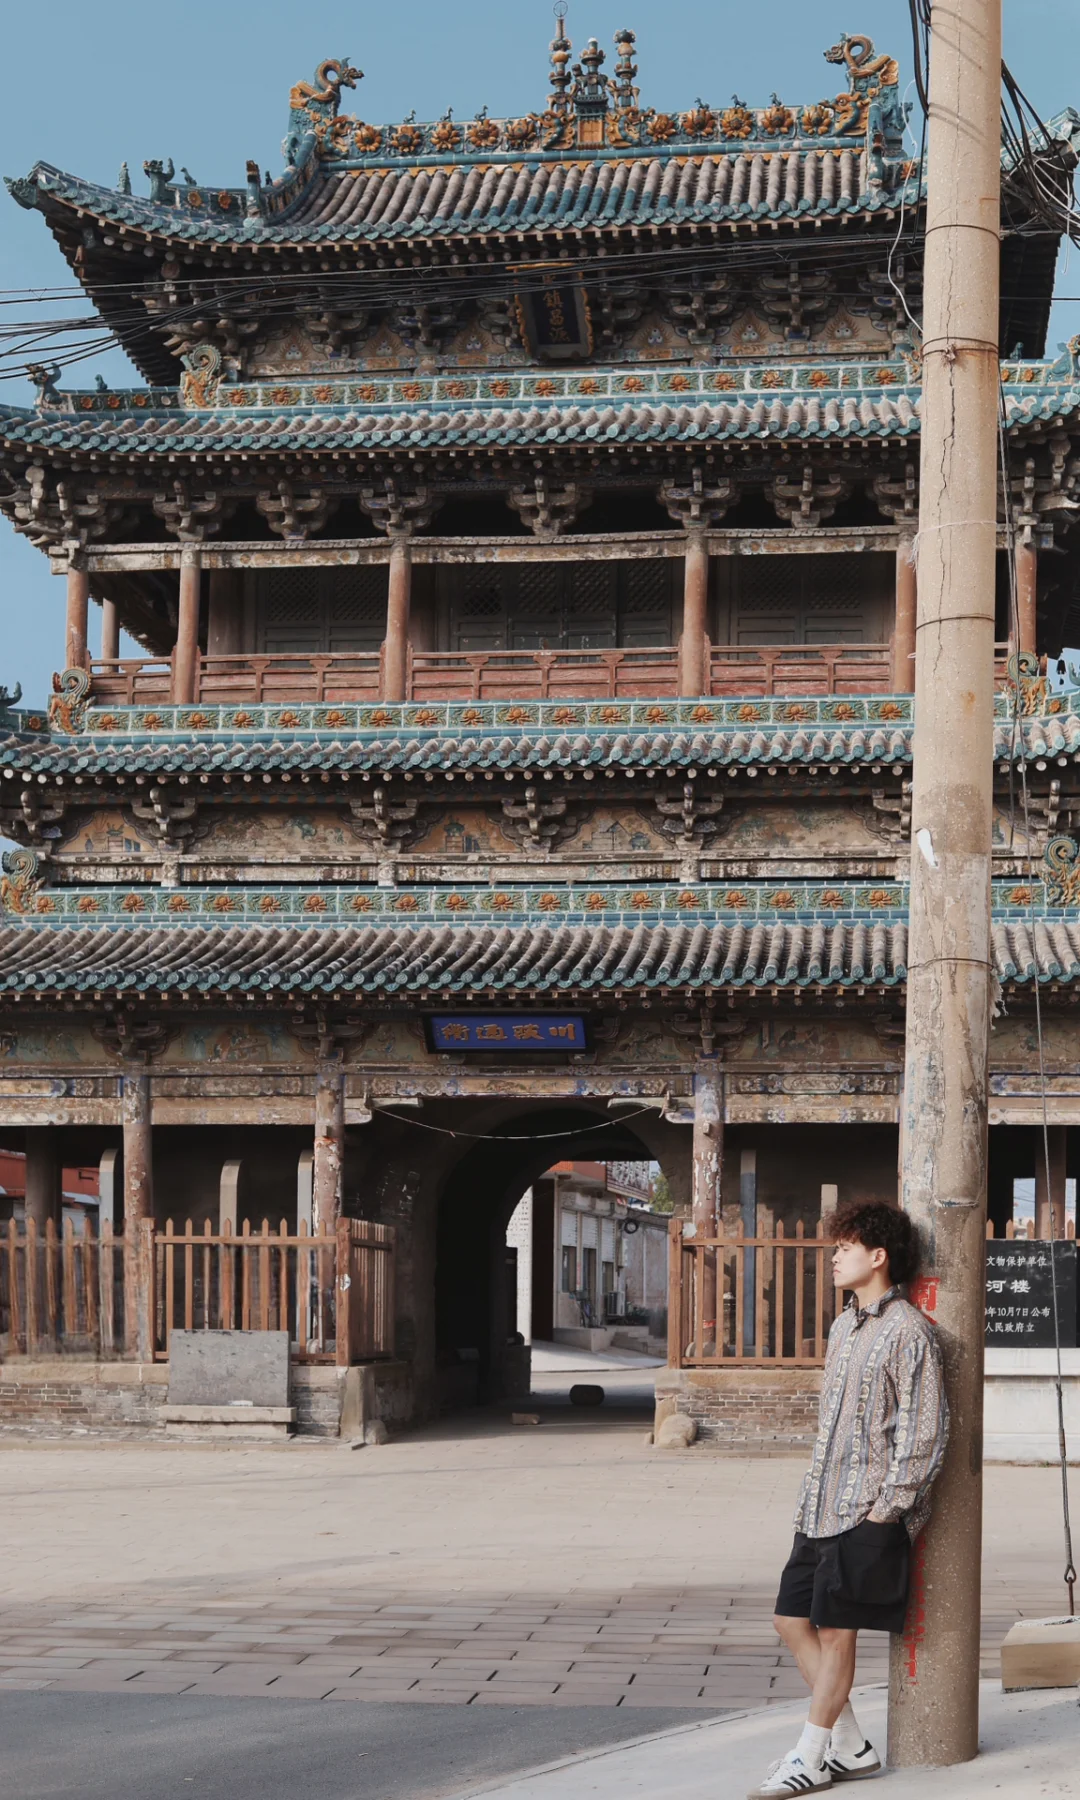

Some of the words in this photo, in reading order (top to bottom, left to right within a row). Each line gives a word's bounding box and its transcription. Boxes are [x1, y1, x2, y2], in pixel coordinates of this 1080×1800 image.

[986, 1256, 1048, 1267] 文物保护单位
[985, 1279, 1031, 1293] 河楼
[984, 1306, 1051, 1317] 年10月7日公布
[984, 1322, 1035, 1333] 人民政府立
